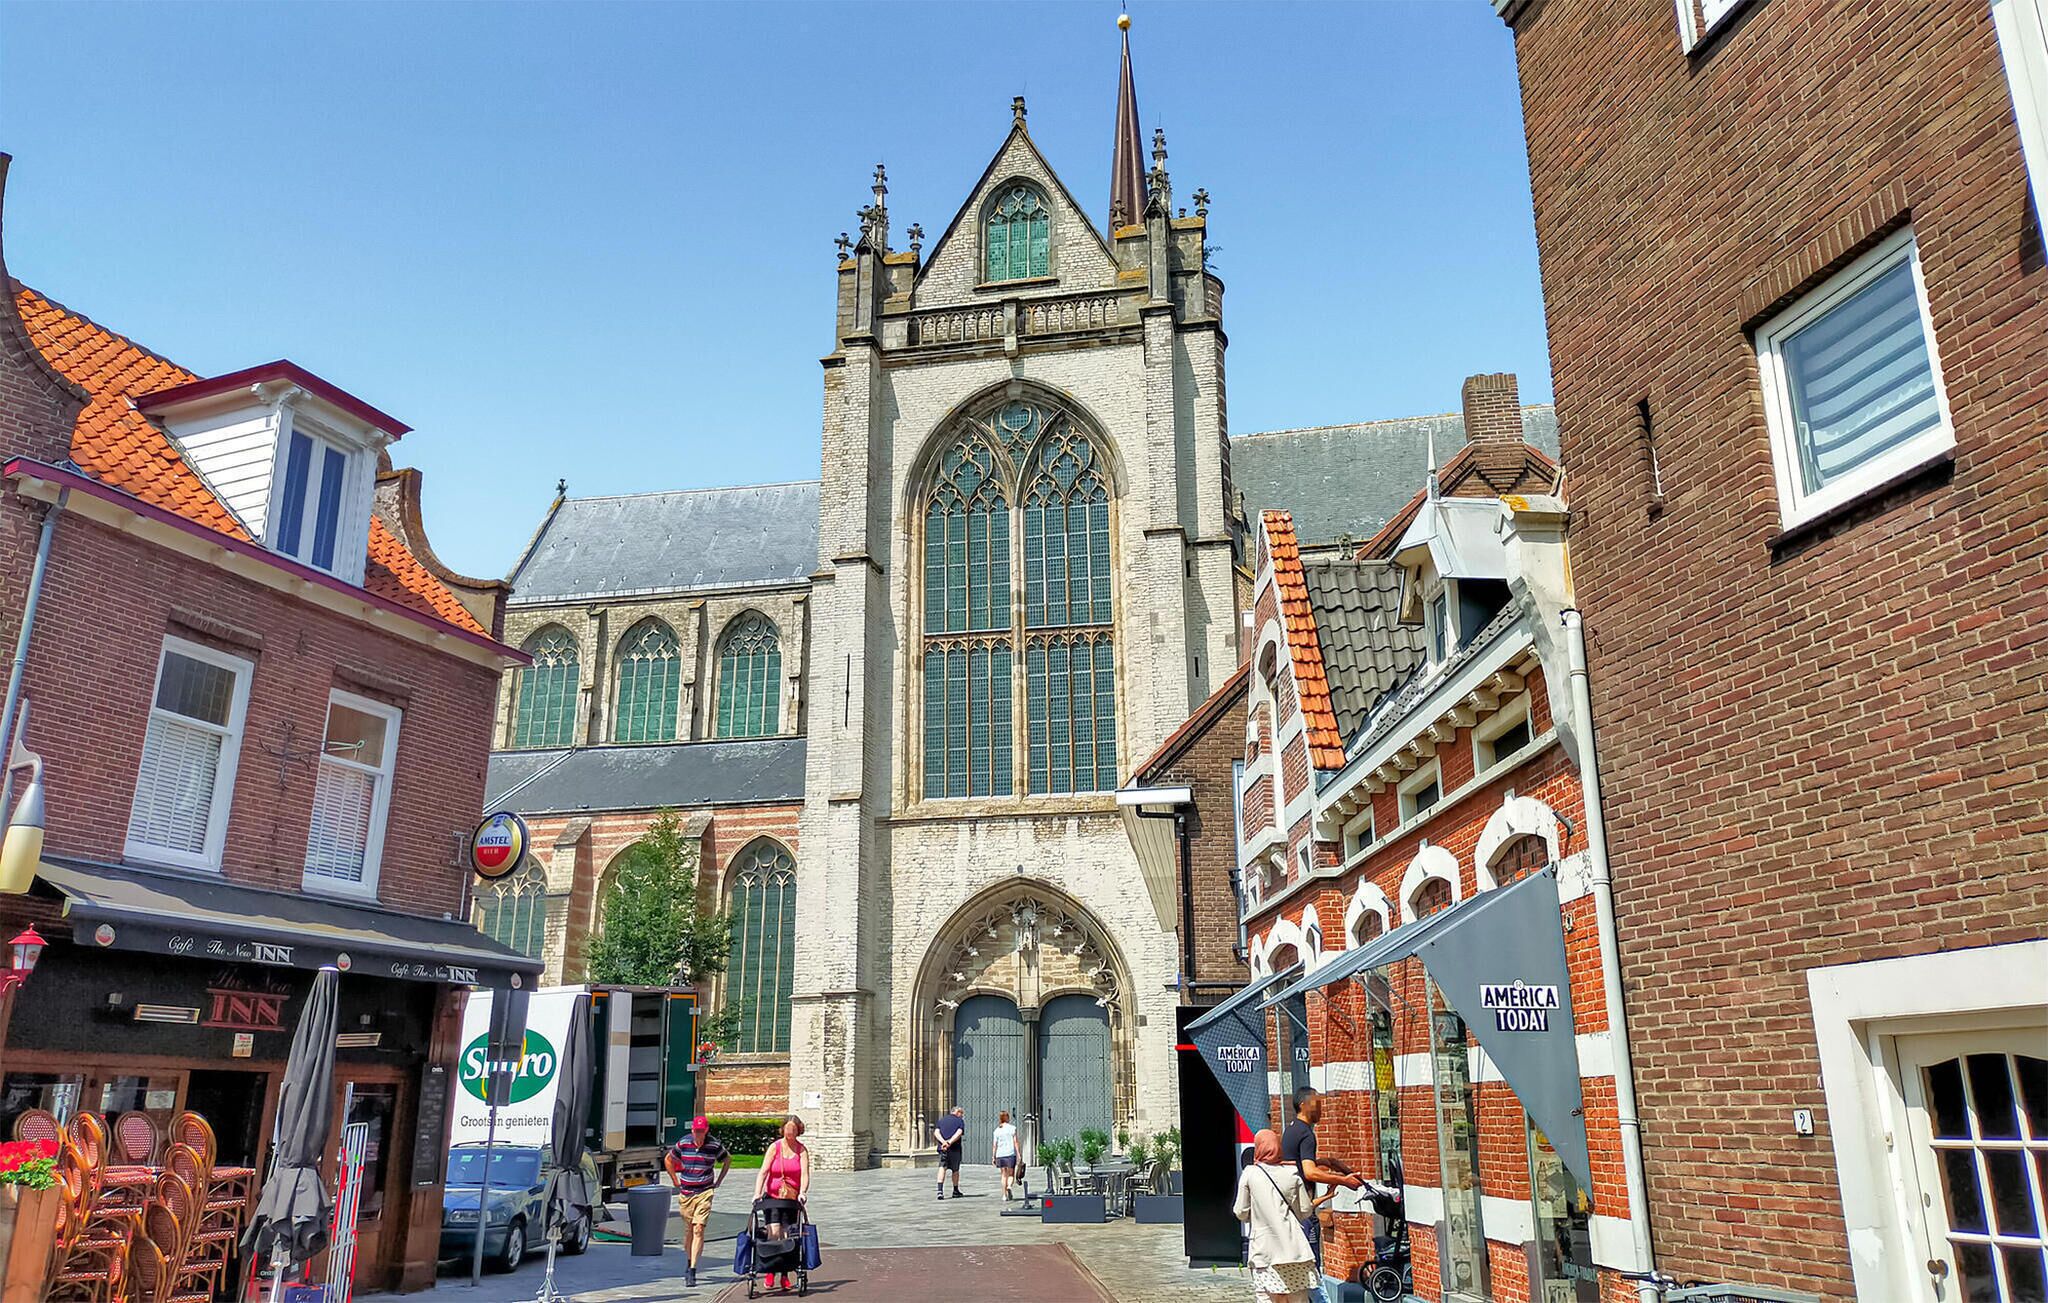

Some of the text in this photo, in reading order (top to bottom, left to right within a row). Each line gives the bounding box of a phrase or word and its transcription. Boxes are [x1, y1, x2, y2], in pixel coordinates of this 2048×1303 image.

[479, 836, 508, 845] AMSTEL
[207, 940, 226, 955] The
[227, 943, 252, 957] New
[252, 942, 293, 965] INN
[413, 965, 428, 977] The
[446, 966, 478, 984] INN
[1484, 986, 1557, 1007] AMERICA
[204, 989, 288, 1030] INN
[1497, 1009, 1545, 1030] TODAY
[1219, 1047, 1258, 1059] AMERICA
[1226, 1061, 1252, 1072] TODAY
[505, 1115, 549, 1129] genieten
[1800, 1112, 1807, 1131] 2
